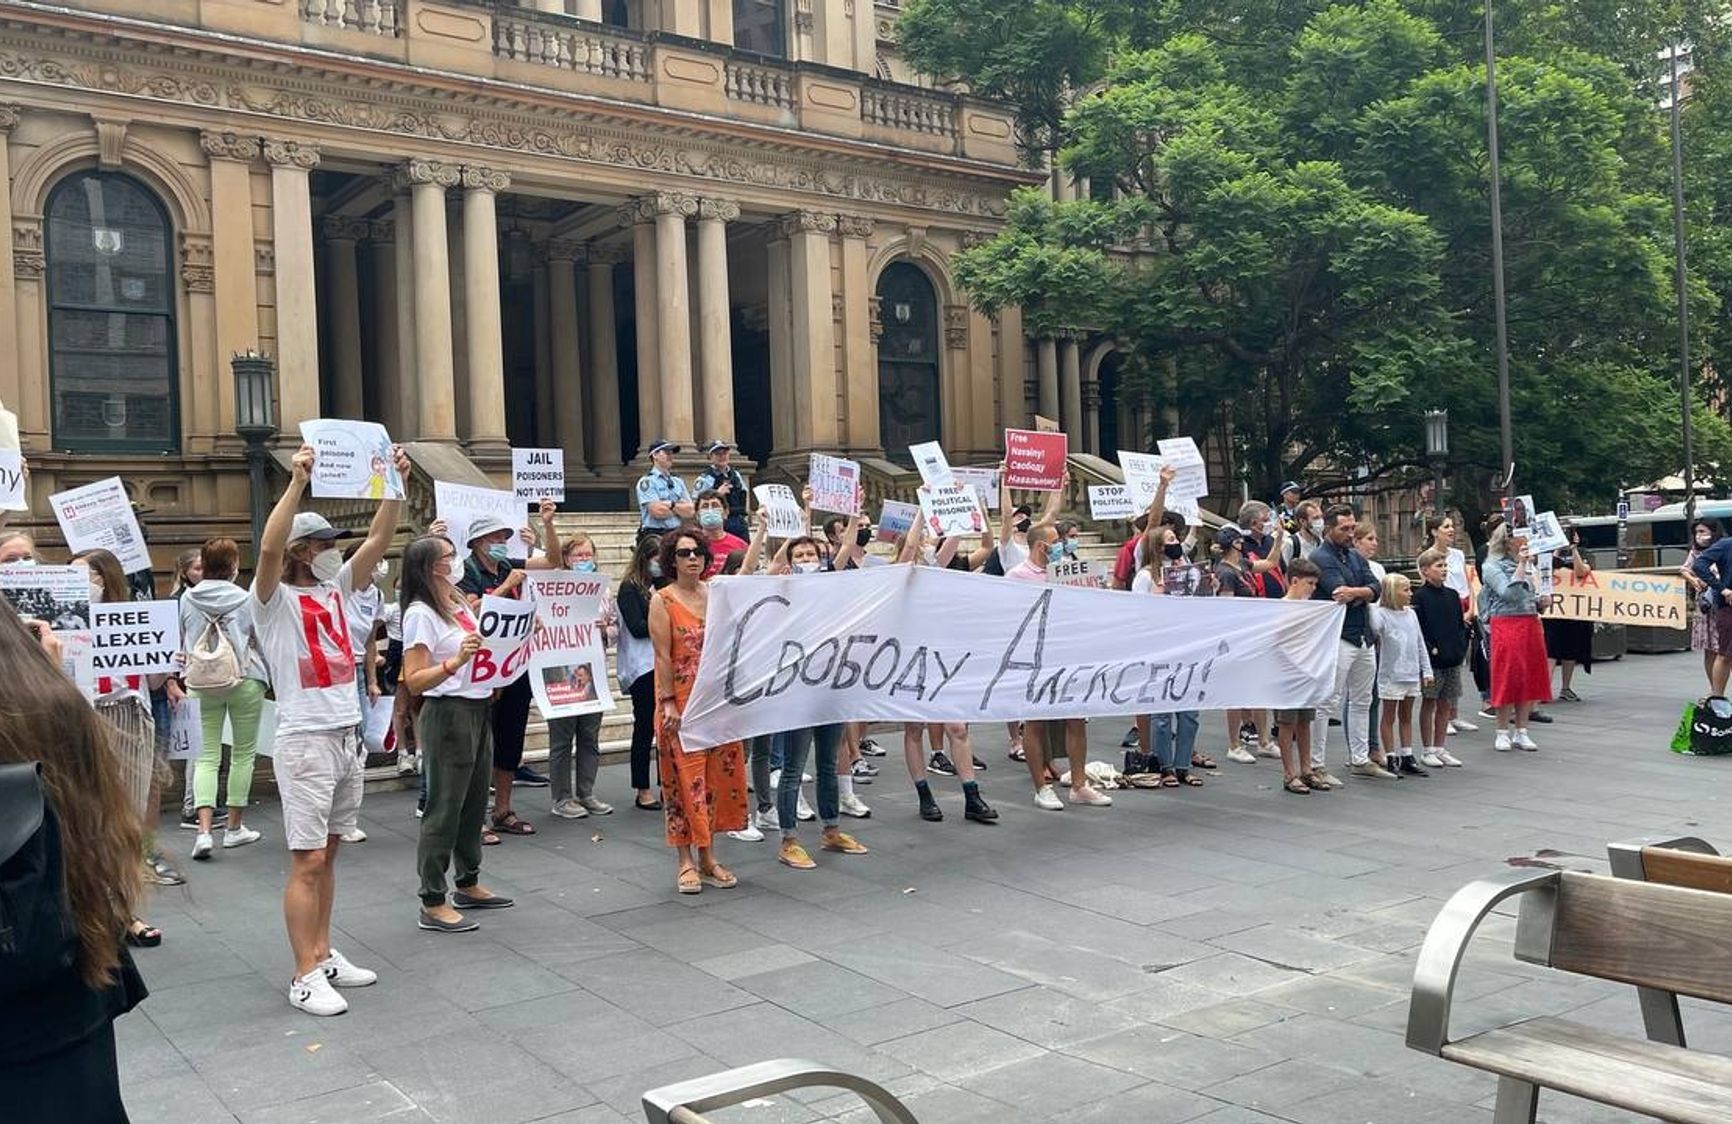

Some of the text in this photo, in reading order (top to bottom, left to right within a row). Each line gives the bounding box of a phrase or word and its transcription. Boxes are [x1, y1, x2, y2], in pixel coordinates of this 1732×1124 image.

[1010, 433, 1028, 443] Free
[527, 453, 552, 465] JAIL
[1010, 461, 1046, 473] Свободу
[516, 472, 563, 480] POISONERS
[516, 488, 534, 497] NOT
[1098, 487, 1124, 496] STOP
[931, 497, 972, 506] POLITICAL
[1092, 498, 1134, 507] POLITICAL
[1055, 561, 1088, 577] FREE
[537, 582, 601, 596] REEDOM
[1611, 579, 1670, 593] NOW
[551, 602, 570, 617] for
[1550, 593, 1680, 620] RTH KOREA
[96, 611, 150, 627] FREE
[92, 631, 165, 649] LEXEY
[93, 651, 175, 669] AVALNY
